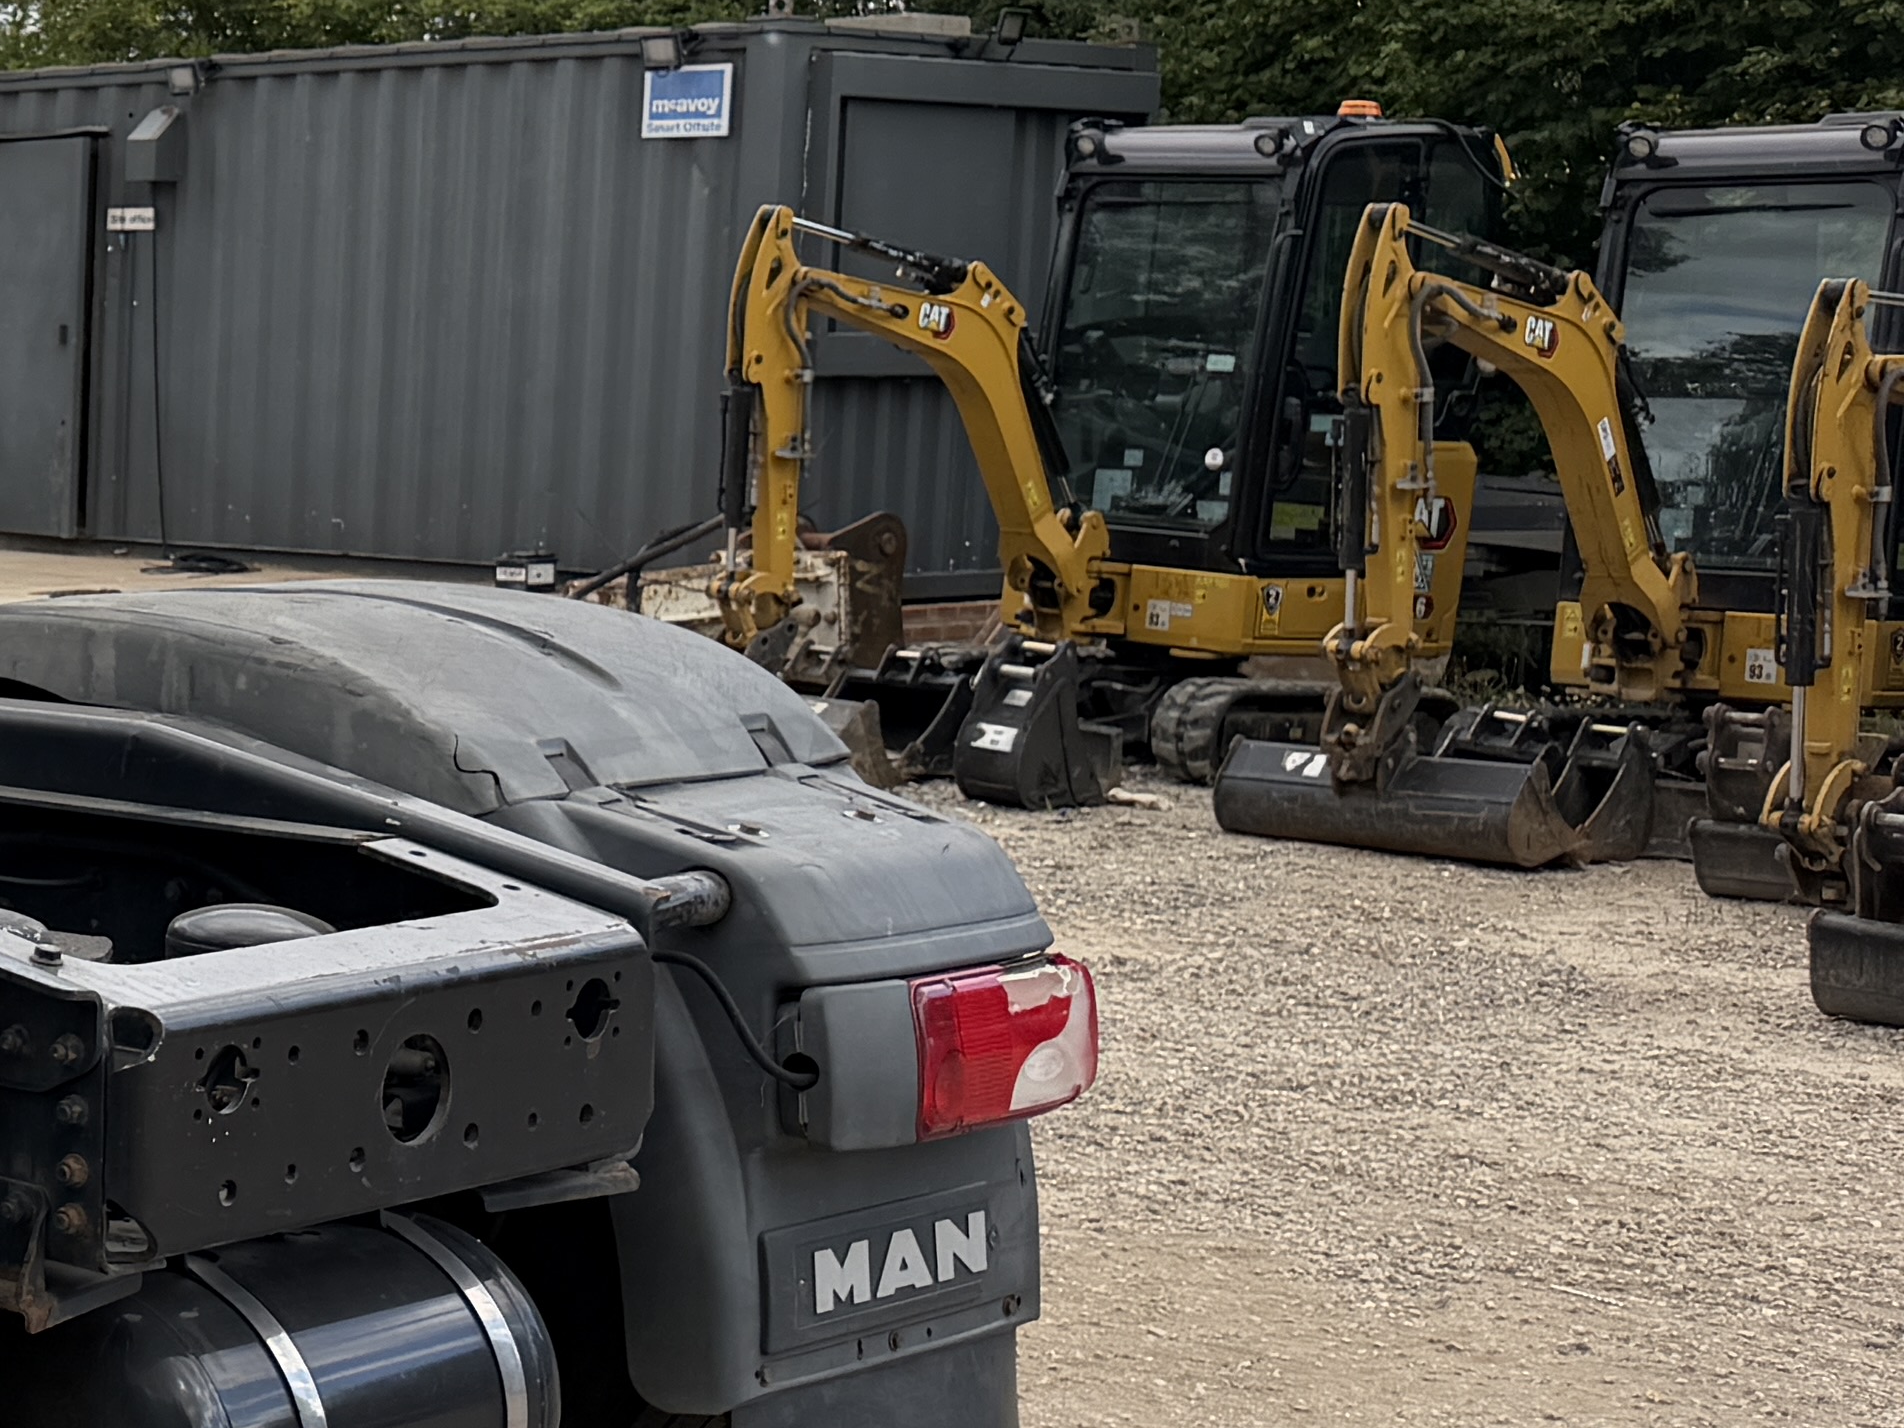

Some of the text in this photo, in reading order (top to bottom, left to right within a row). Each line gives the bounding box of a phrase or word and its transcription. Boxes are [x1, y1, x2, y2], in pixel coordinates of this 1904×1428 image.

[918, 302, 950, 332] CAT
[1525, 315, 1553, 350] CAT
[1414, 497, 1445, 539] AT
[1749, 663, 1764, 681] 93
[814, 1210, 988, 1314] MAN
